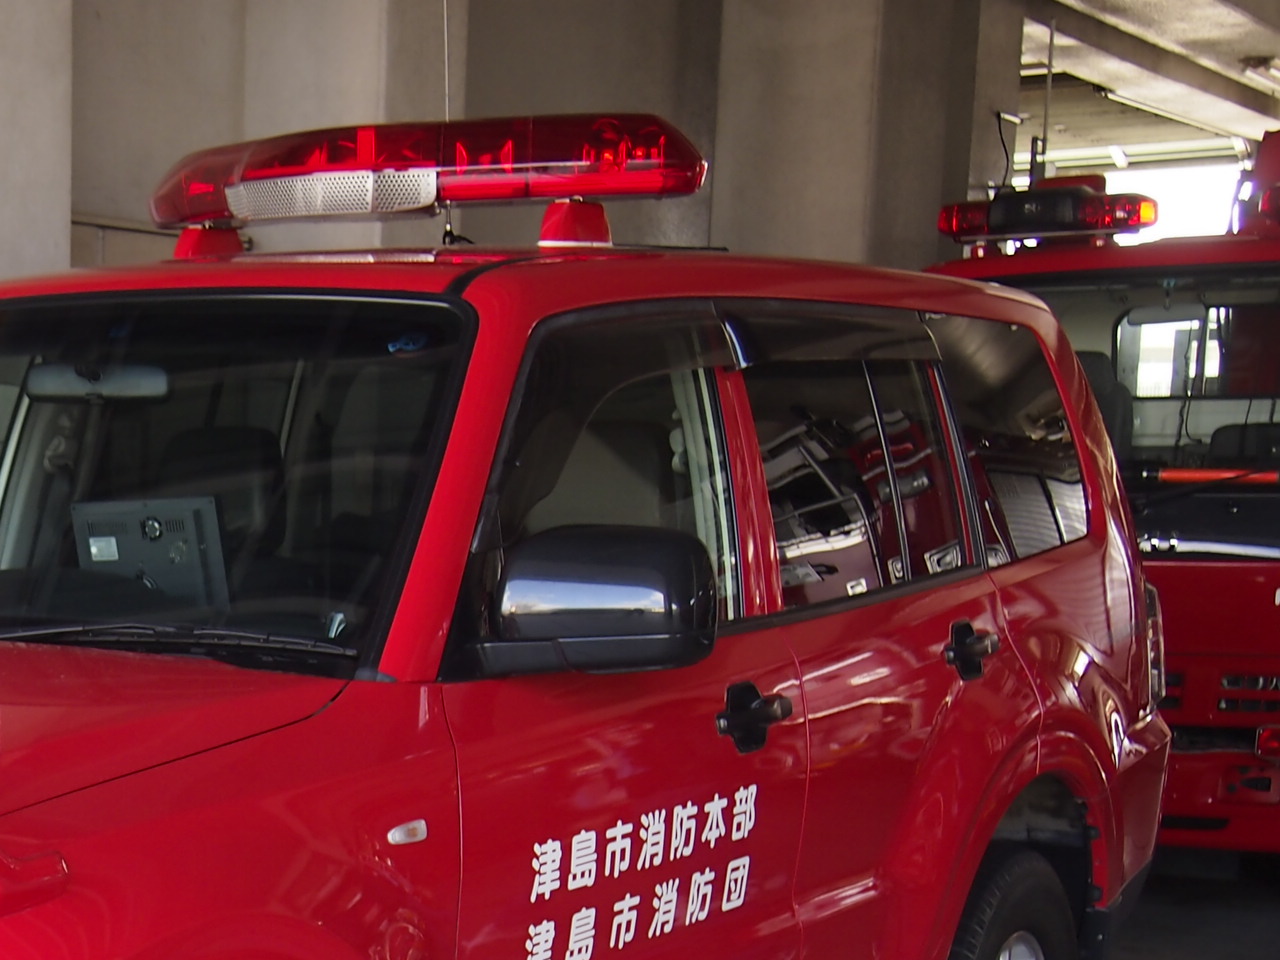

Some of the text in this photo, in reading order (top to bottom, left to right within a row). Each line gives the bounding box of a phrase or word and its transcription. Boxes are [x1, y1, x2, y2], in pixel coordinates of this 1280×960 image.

[530, 783, 757, 904] 津島市消防本部
